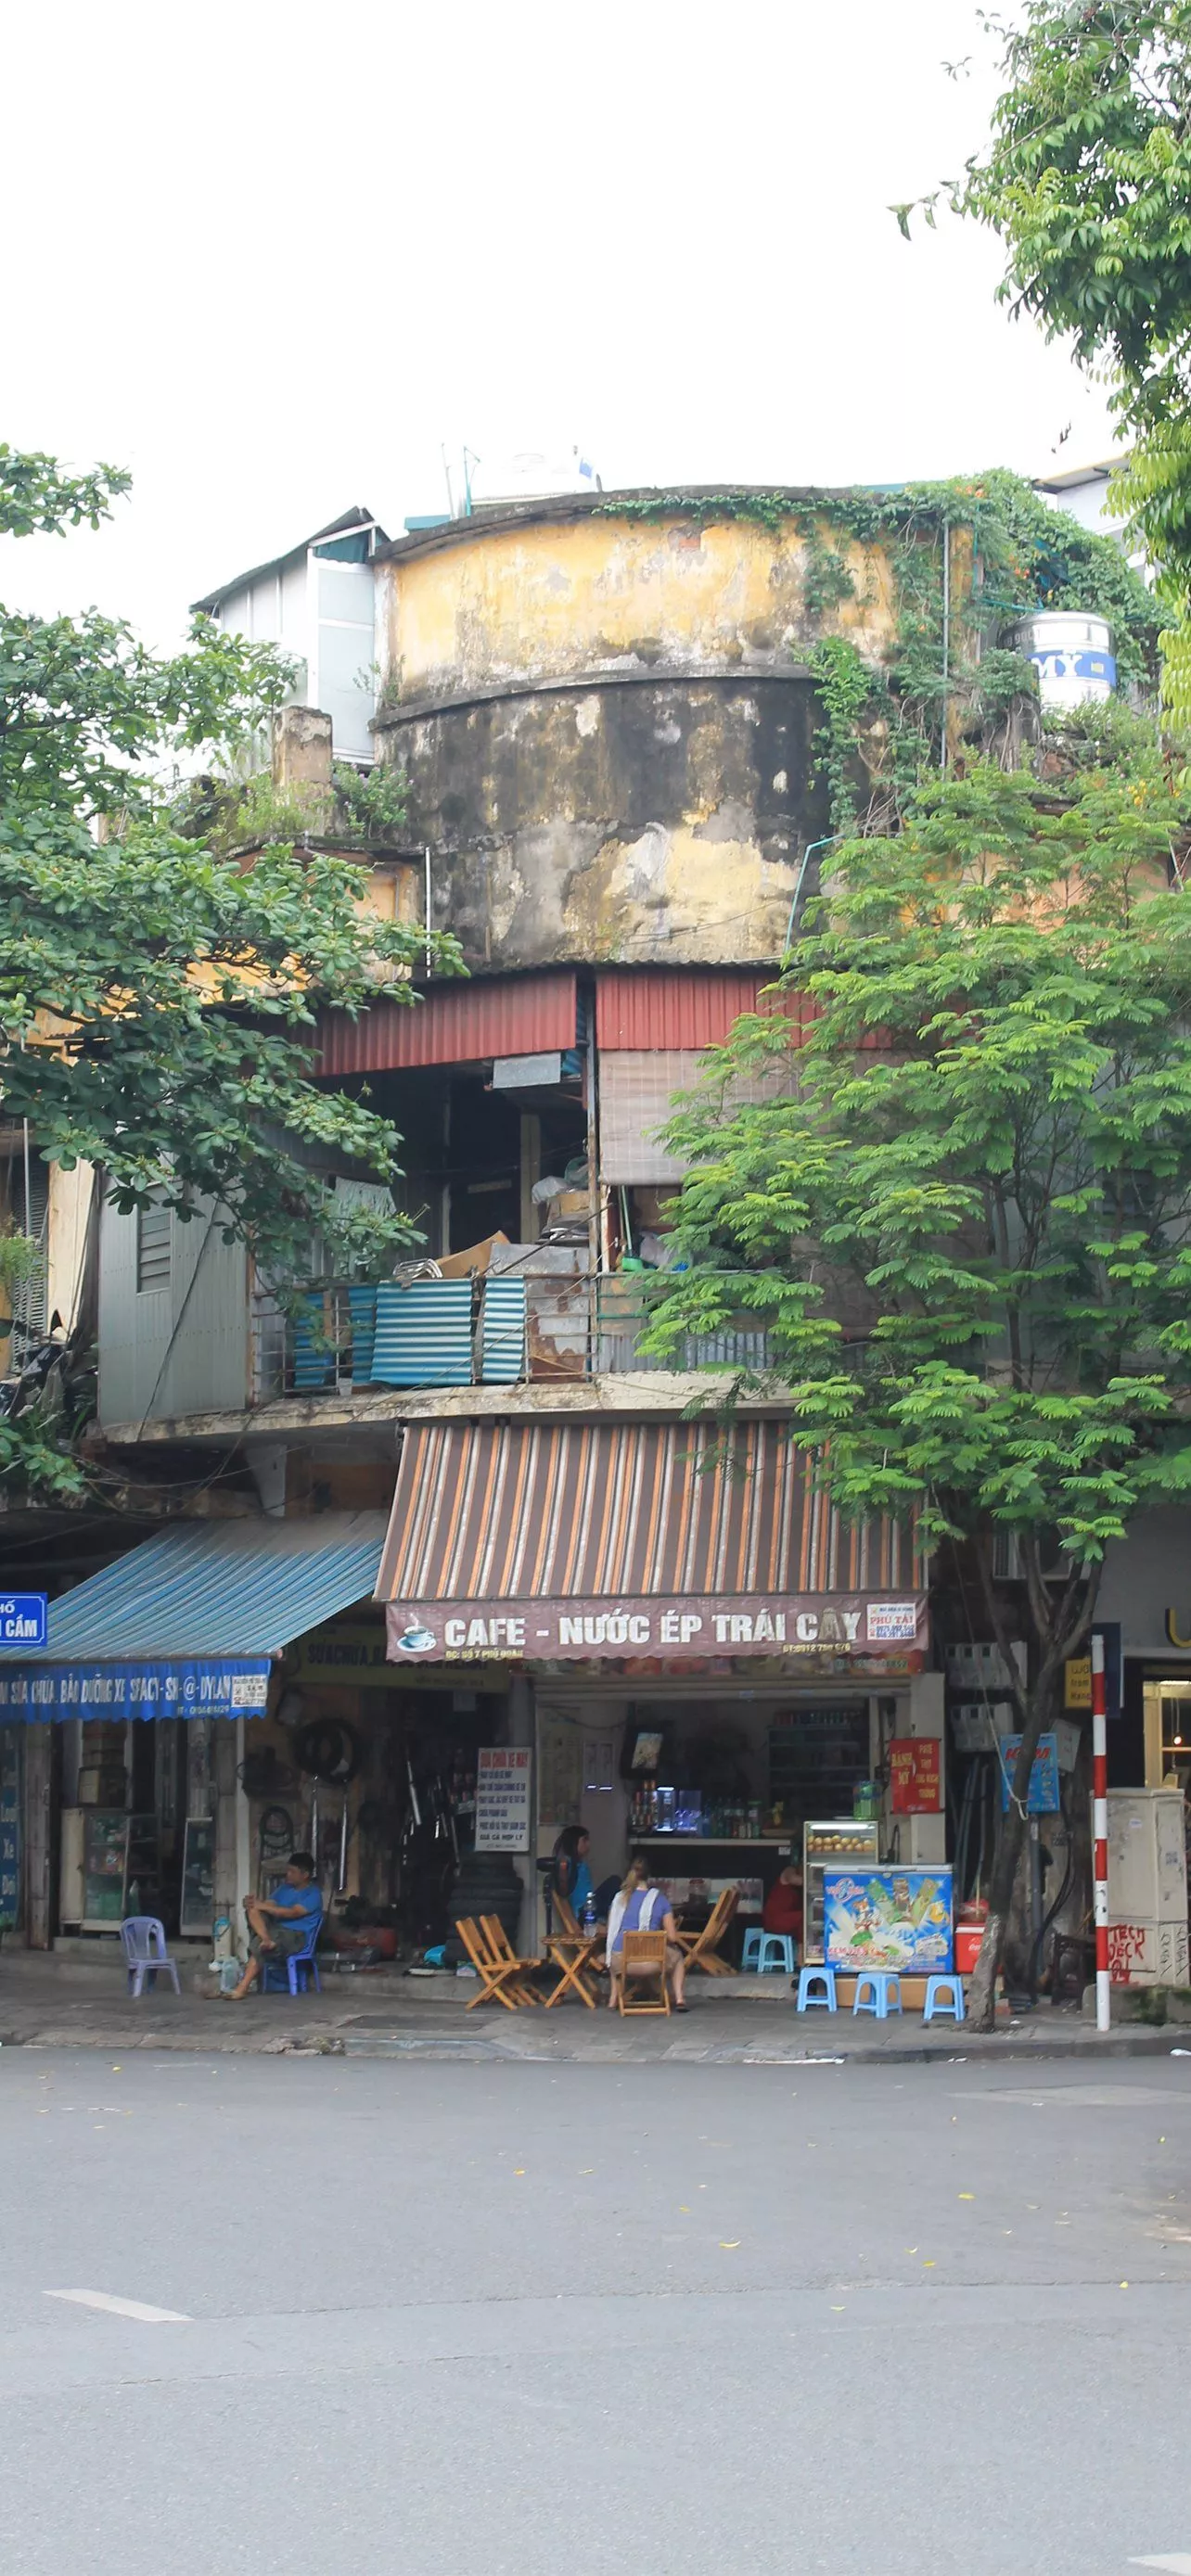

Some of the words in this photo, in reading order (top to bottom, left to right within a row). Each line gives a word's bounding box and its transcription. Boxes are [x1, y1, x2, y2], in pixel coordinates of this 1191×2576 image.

[444, 1617, 526, 1647] CAFE
[559, 1608, 649, 1645] NƯỚC
[660, 1610, 702, 1643] ÉP
[711, 1609, 786, 1642] TRÁI
[797, 1607, 861, 1641] CÂY
[1005, 1747, 1051, 1761] KM
